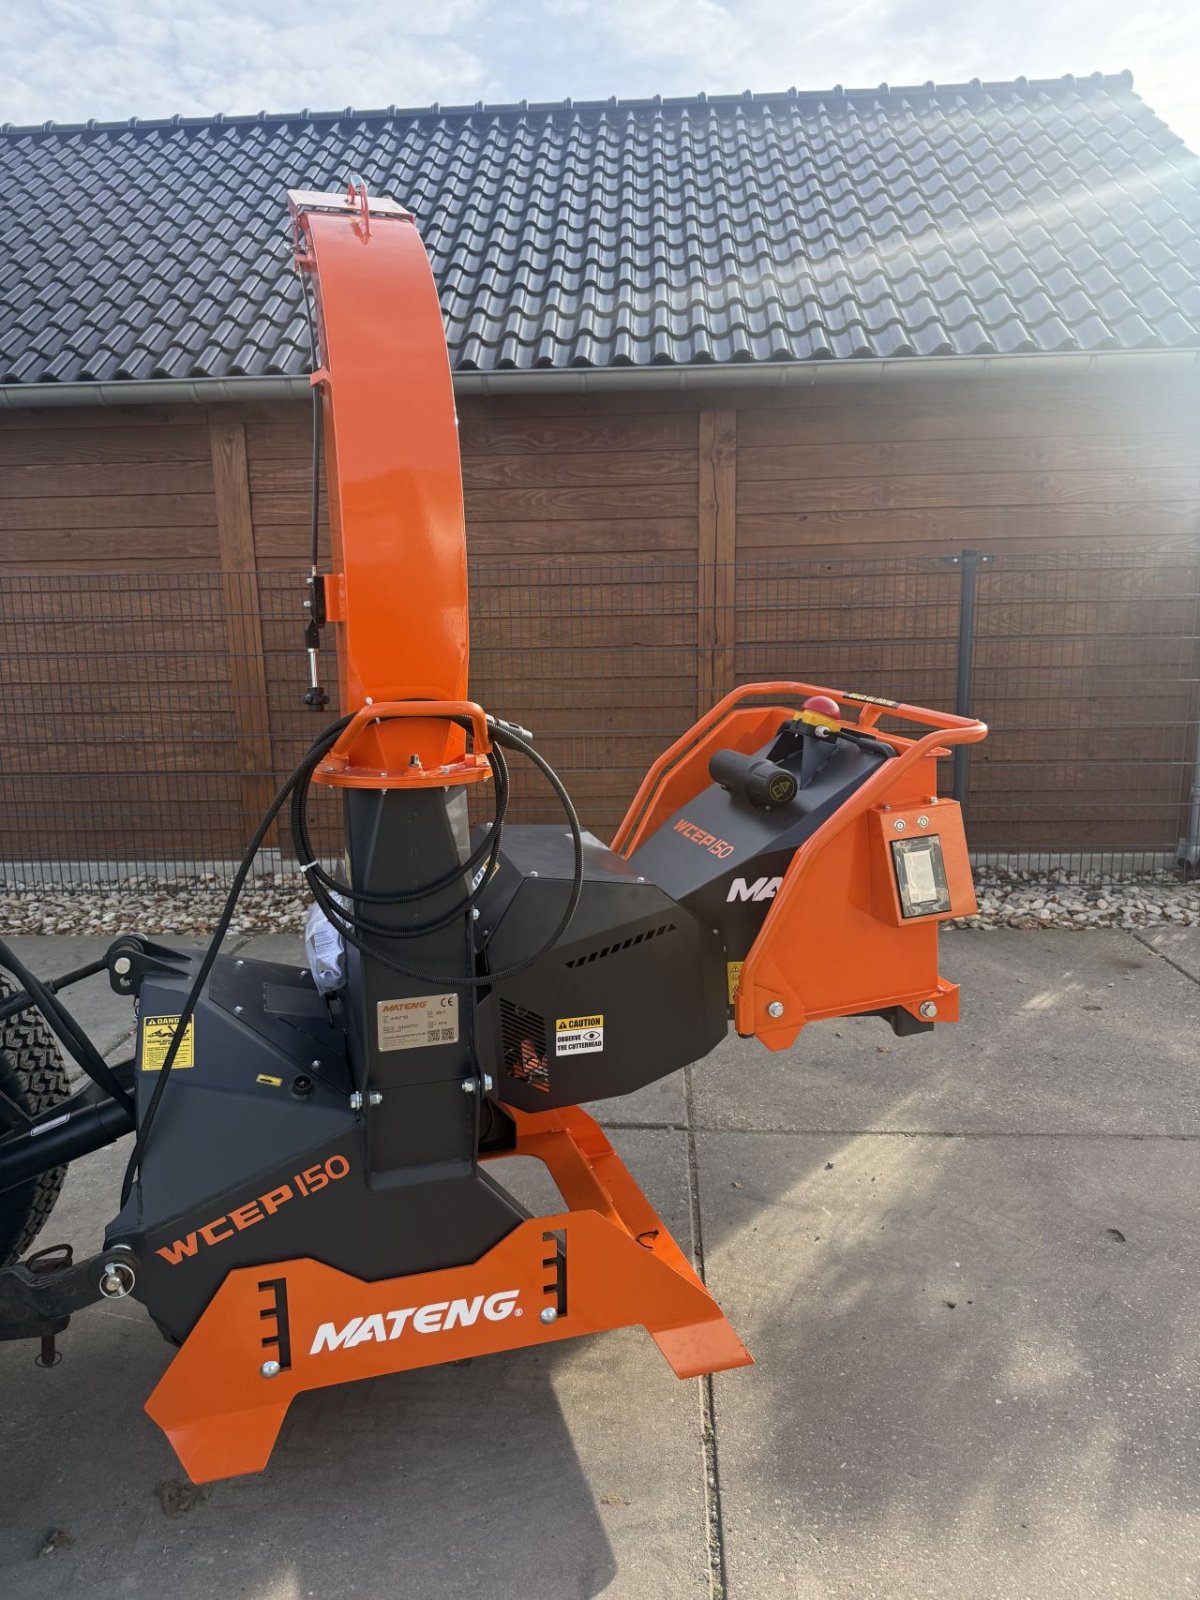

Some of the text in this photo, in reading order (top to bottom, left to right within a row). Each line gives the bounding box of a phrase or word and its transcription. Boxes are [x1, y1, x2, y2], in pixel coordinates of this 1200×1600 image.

[673, 818, 735, 859] WCEP150
[726, 876, 785, 902] MA
[383, 1001, 428, 1013] MATENG
[568, 1017, 601, 1029] CAUTION
[557, 1034, 581, 1043] OBSERVE
[568, 1040, 602, 1051] CUTTERHEAD
[154, 1154, 351, 1266] WCEP150
